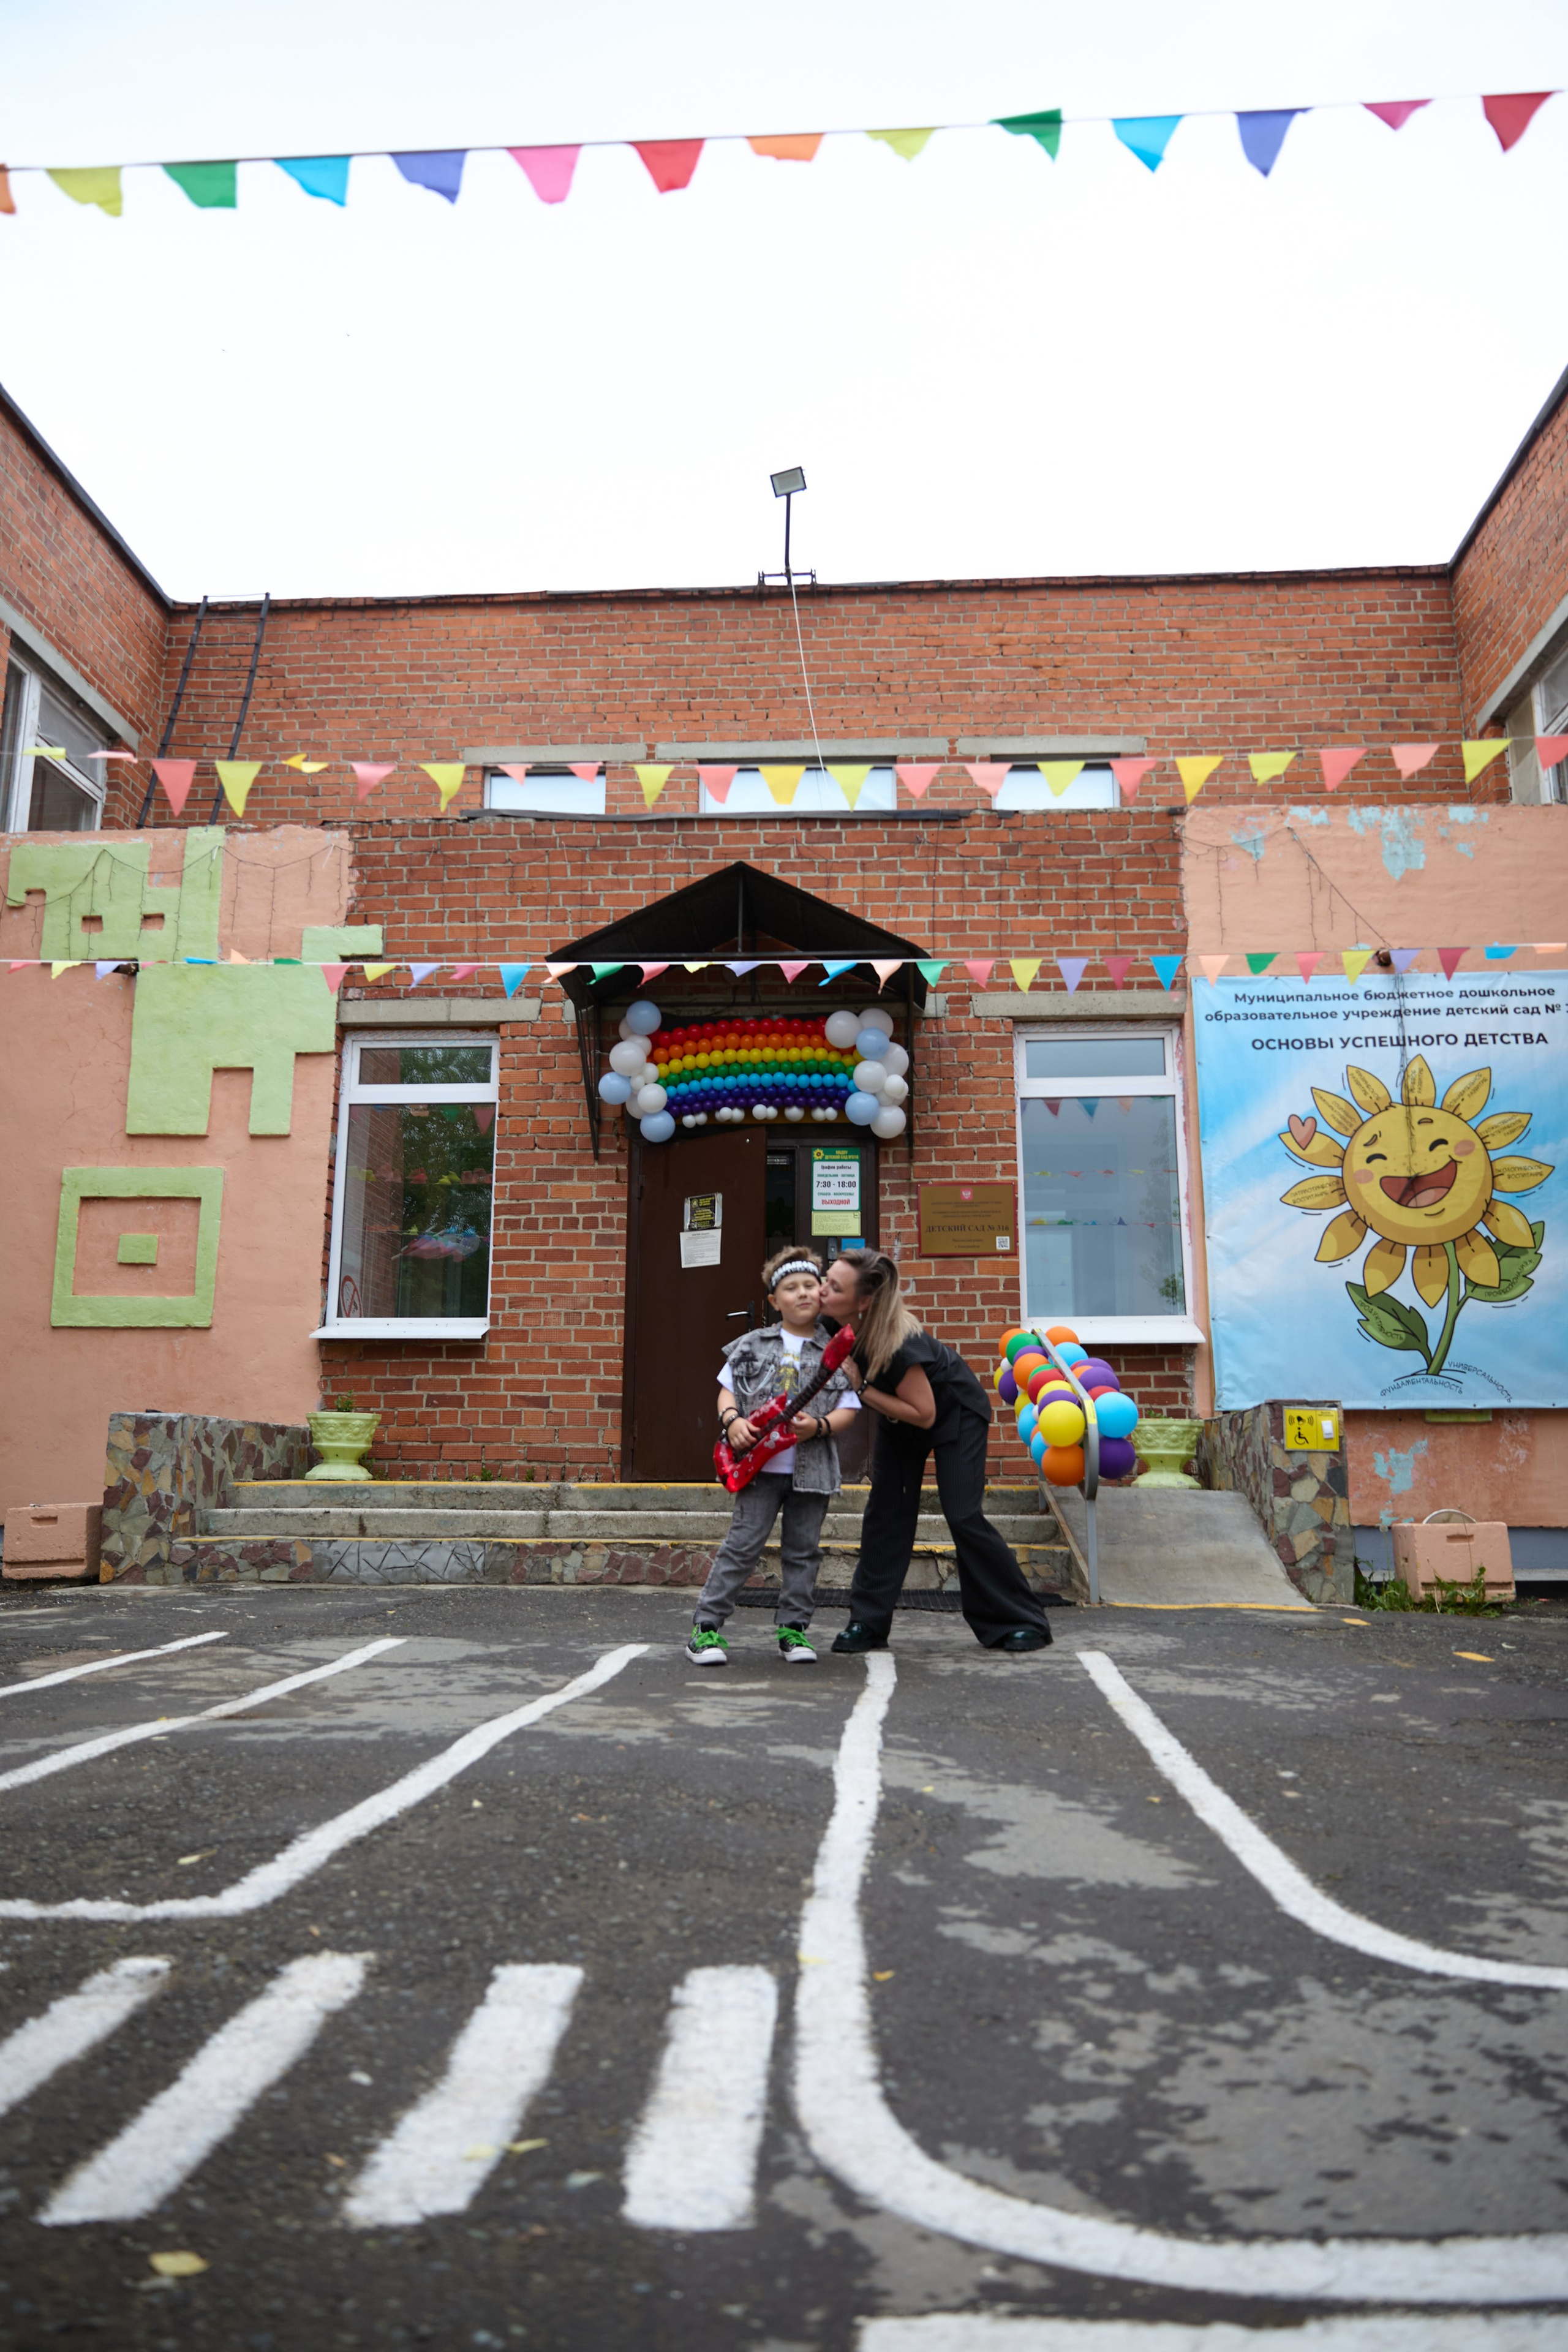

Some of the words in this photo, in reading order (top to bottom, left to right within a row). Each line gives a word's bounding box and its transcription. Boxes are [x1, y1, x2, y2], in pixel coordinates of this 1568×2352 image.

[1234, 991, 1359, 1004] Муниципальное
[1363, 989, 1454, 1001] бюджетное
[1459, 987, 1555, 999] дошкольное
[1205, 1008, 1338, 1023] образовательное
[1343, 1008, 1442, 1023] учреждение
[1446, 1003, 1509, 1017] детский
[1513, 1006, 1540, 1016] сад
[1545, 1003, 1561, 1014] №
[1251, 1037, 1333, 1050] ОСНОВЫ
[1340, 1035, 1458, 1049] УСПЕШНОГО
[1464, 1032, 1549, 1047] ДЕТСТВА
[925, 1224, 966, 1233] ДЕТСКИЙ
[968, 1224, 985, 1233] САД
[1357, 1300, 1404, 1341] ПРОДУКТИВНОСТЬ
[1380, 1378, 1463, 1397] ФУНДАМЕНТАЛЬНОСТЬ
[1447, 1361, 1513, 1403] УНИВЕРСАЛЬНОСТЬ
